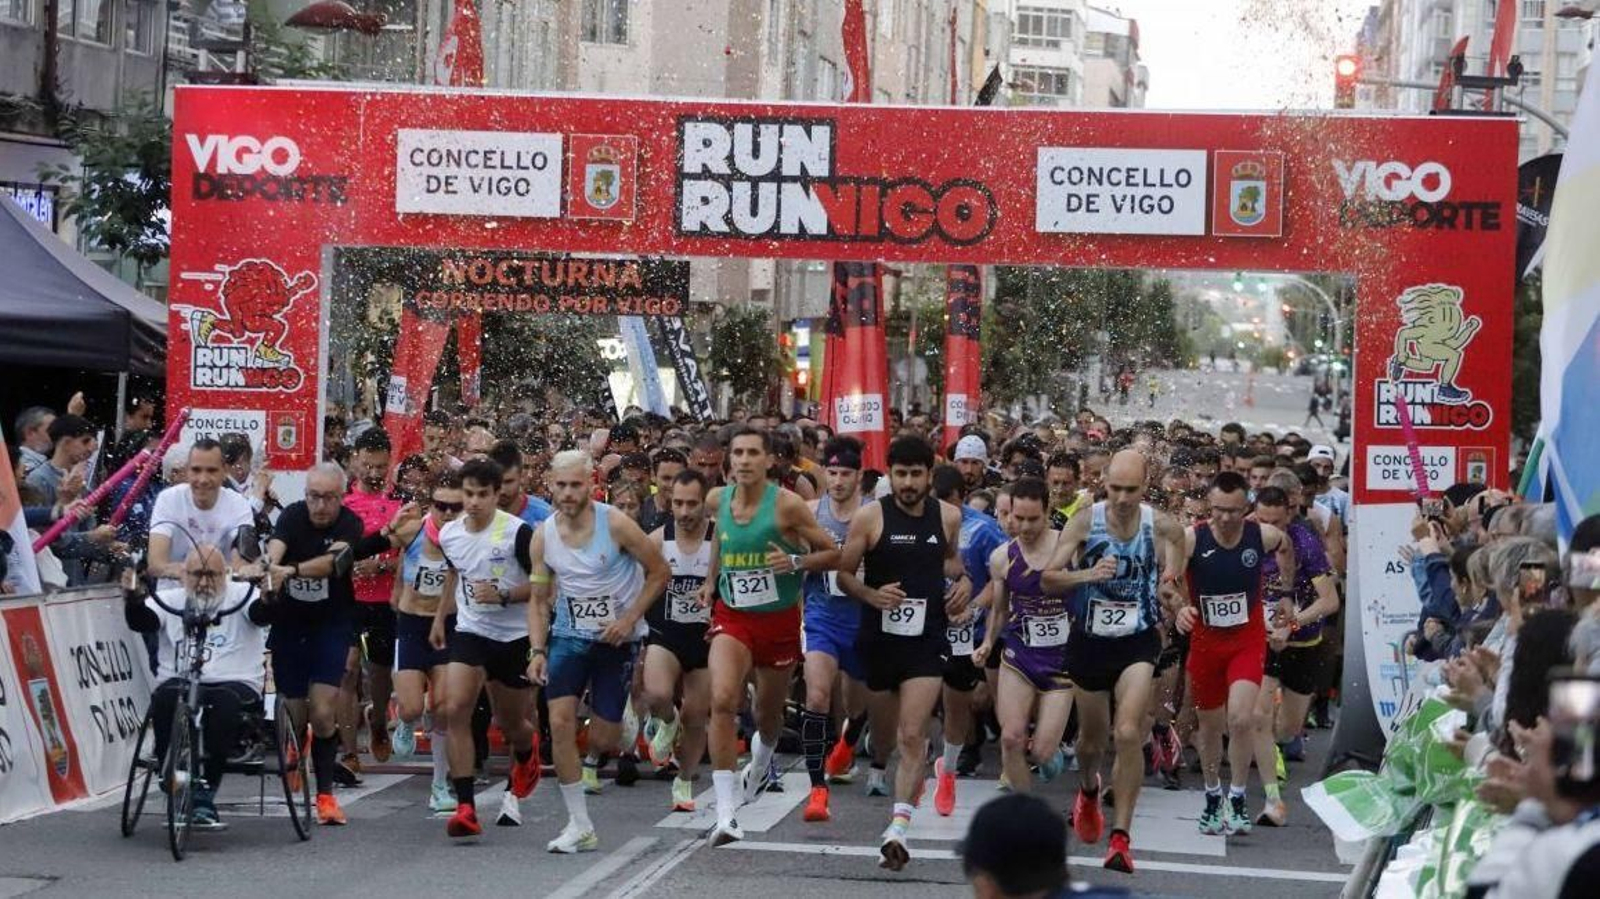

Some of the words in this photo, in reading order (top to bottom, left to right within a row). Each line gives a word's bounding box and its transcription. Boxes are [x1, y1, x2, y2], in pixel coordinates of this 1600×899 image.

[185, 134, 301, 176] VIGO
[684, 121, 830, 177] RUN
[409, 148, 549, 171] CONCELLO
[426, 175, 458, 195] DE
[469, 176, 531, 197] VIGO
[1050, 166, 1192, 188] CONCELLO
[1331, 159, 1452, 202] VIGO
[192, 173, 348, 203] DEPORTE
[1066, 194, 1100, 213] DE
[1111, 194, 1175, 214] VIGO
[1339, 201, 1502, 231] DEPORTE
[441, 258, 643, 289] NOCTURNA
[415, 289, 551, 314] CORRENDO
[558, 295, 608, 314] POR
[618, 296, 681, 316] VIGO
[196, 347, 247, 368] RUN
[1379, 383, 1433, 403] RUN
[187, 418, 259, 431] CONCELLO
[1373, 454, 1449, 467] CONCLLO
[1382, 469, 1399, 480] DE
[1404, 469, 1440, 481] VGO
[737, 576, 770, 594] 321
[574, 602, 610, 619] 243
[888, 606, 915, 623] 89
[1101, 609, 1127, 626] 32
[1209, 600, 1241, 617] 180
[1034, 623, 1060, 637] 35
